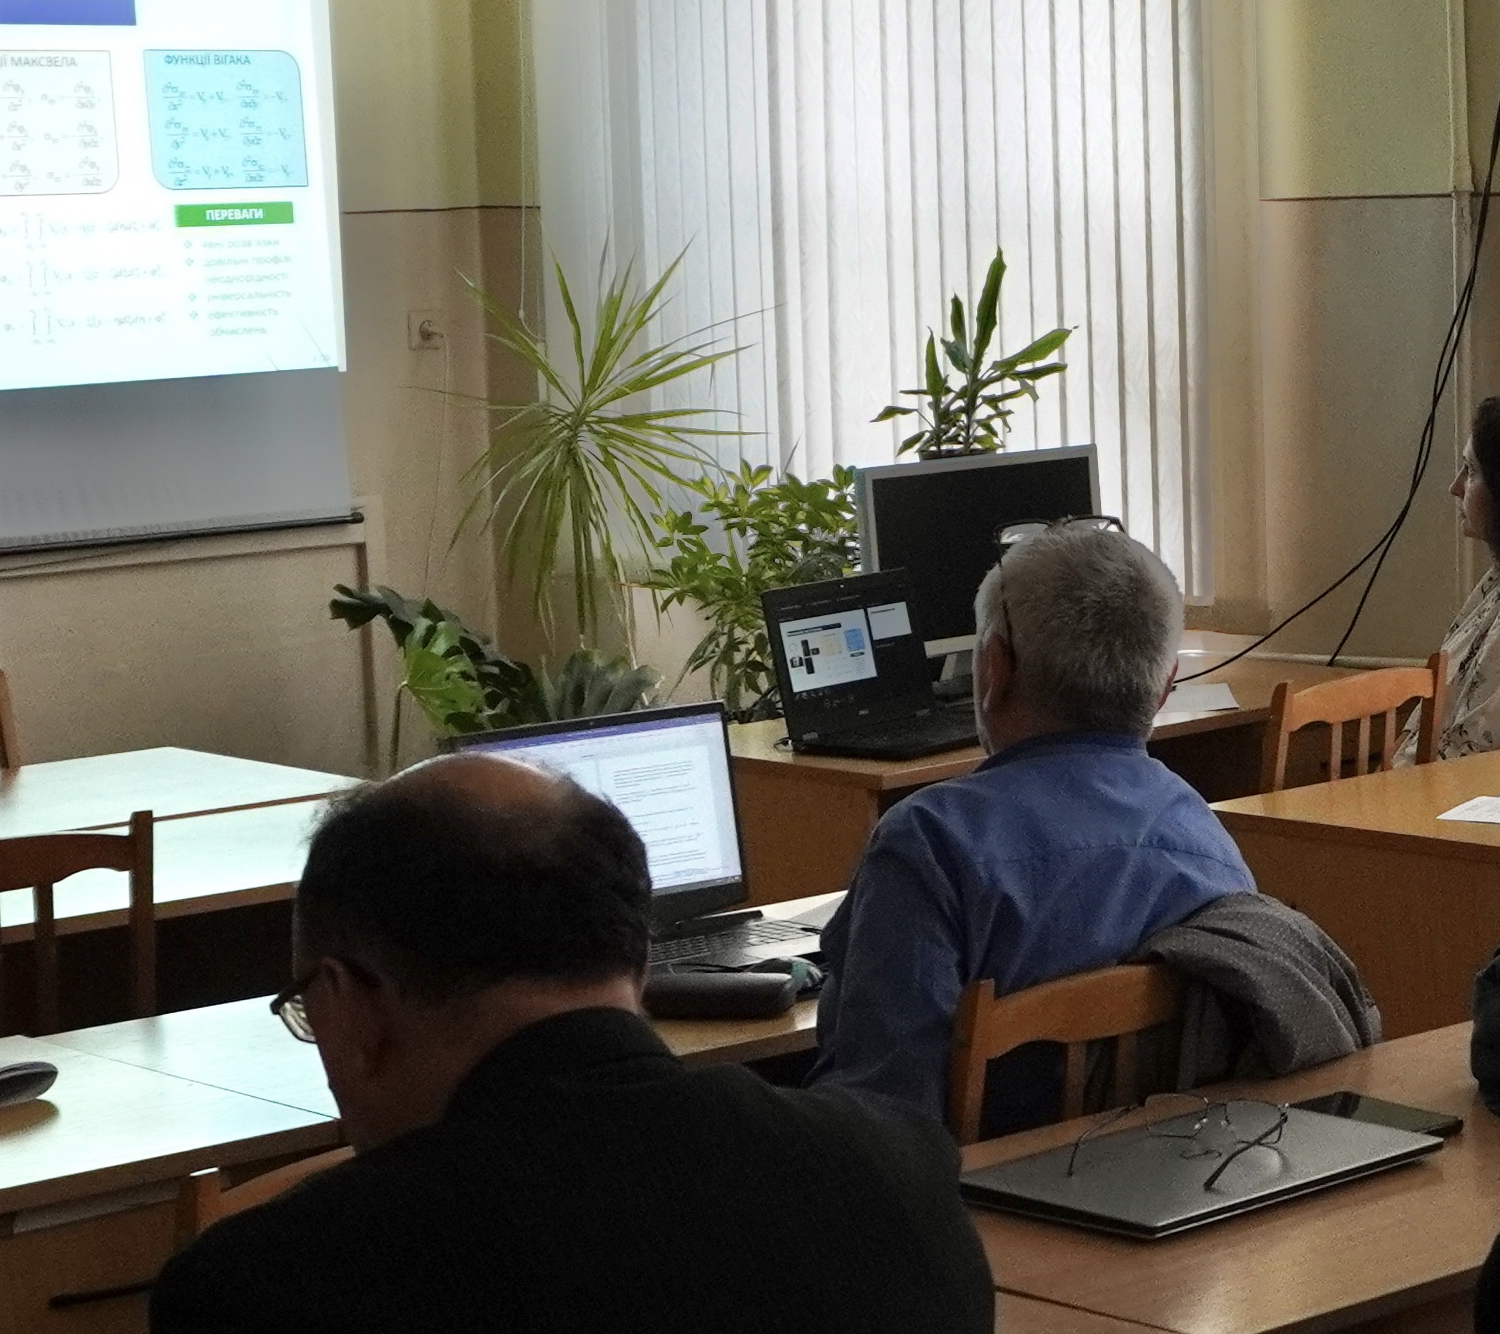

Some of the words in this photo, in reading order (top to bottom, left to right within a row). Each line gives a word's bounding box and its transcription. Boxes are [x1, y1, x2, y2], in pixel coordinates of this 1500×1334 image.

[10, 55, 78, 68] МАКСВЕЛА
[164, 53, 211, 67] ФУНКЦІЇ
[213, 54, 252, 66] ВІГАКА
[206, 208, 264, 221] ПЕРЕВАГИ
